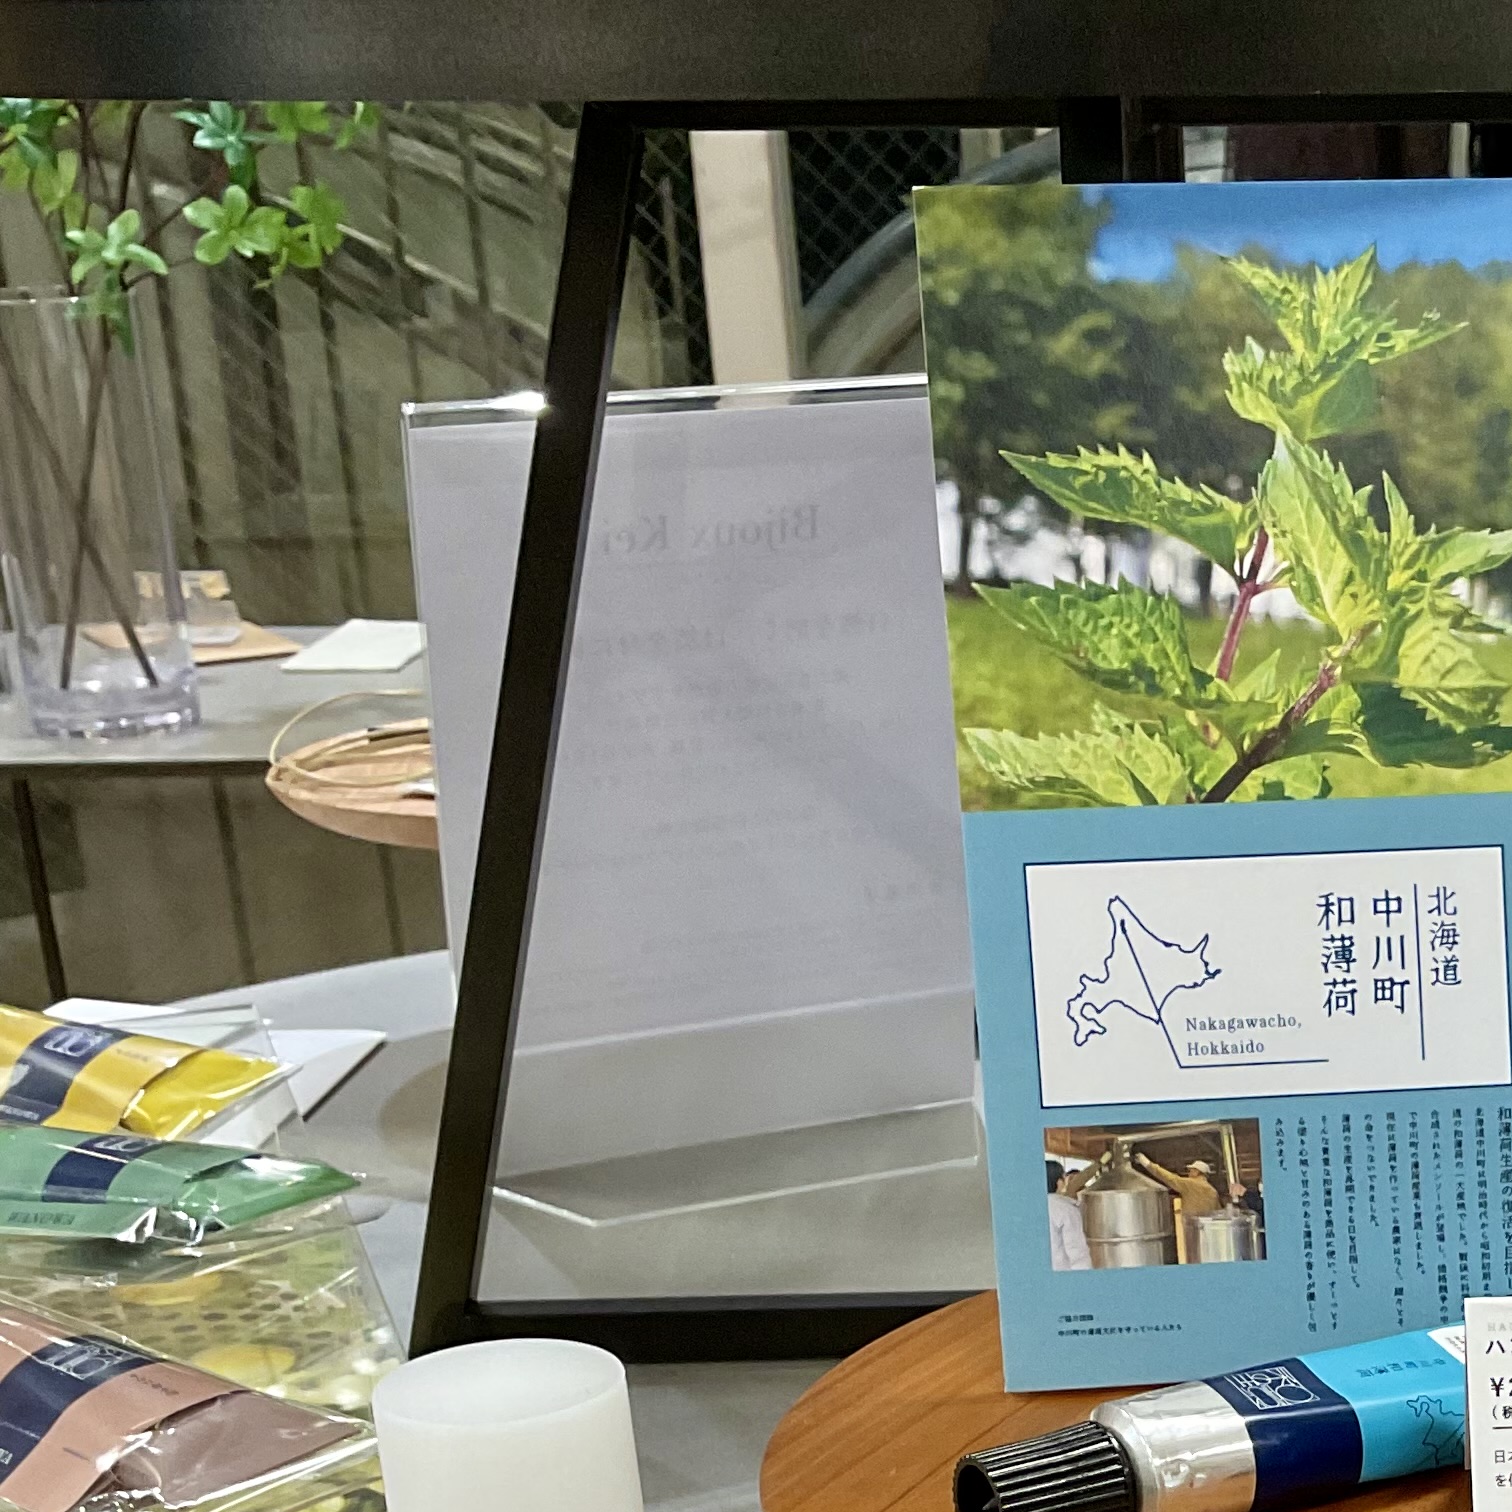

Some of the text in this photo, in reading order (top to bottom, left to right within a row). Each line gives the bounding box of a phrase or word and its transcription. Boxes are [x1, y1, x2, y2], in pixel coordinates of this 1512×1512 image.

[1316, 890, 1358, 1018] 和薄荷
[1372, 888, 1411, 1015] 中川町
[1427, 885, 1463, 988] 北海道
[1185, 1013, 1303, 1034] Nakagawacho,
[1186, 1038, 1266, 1058] Hokkaido
